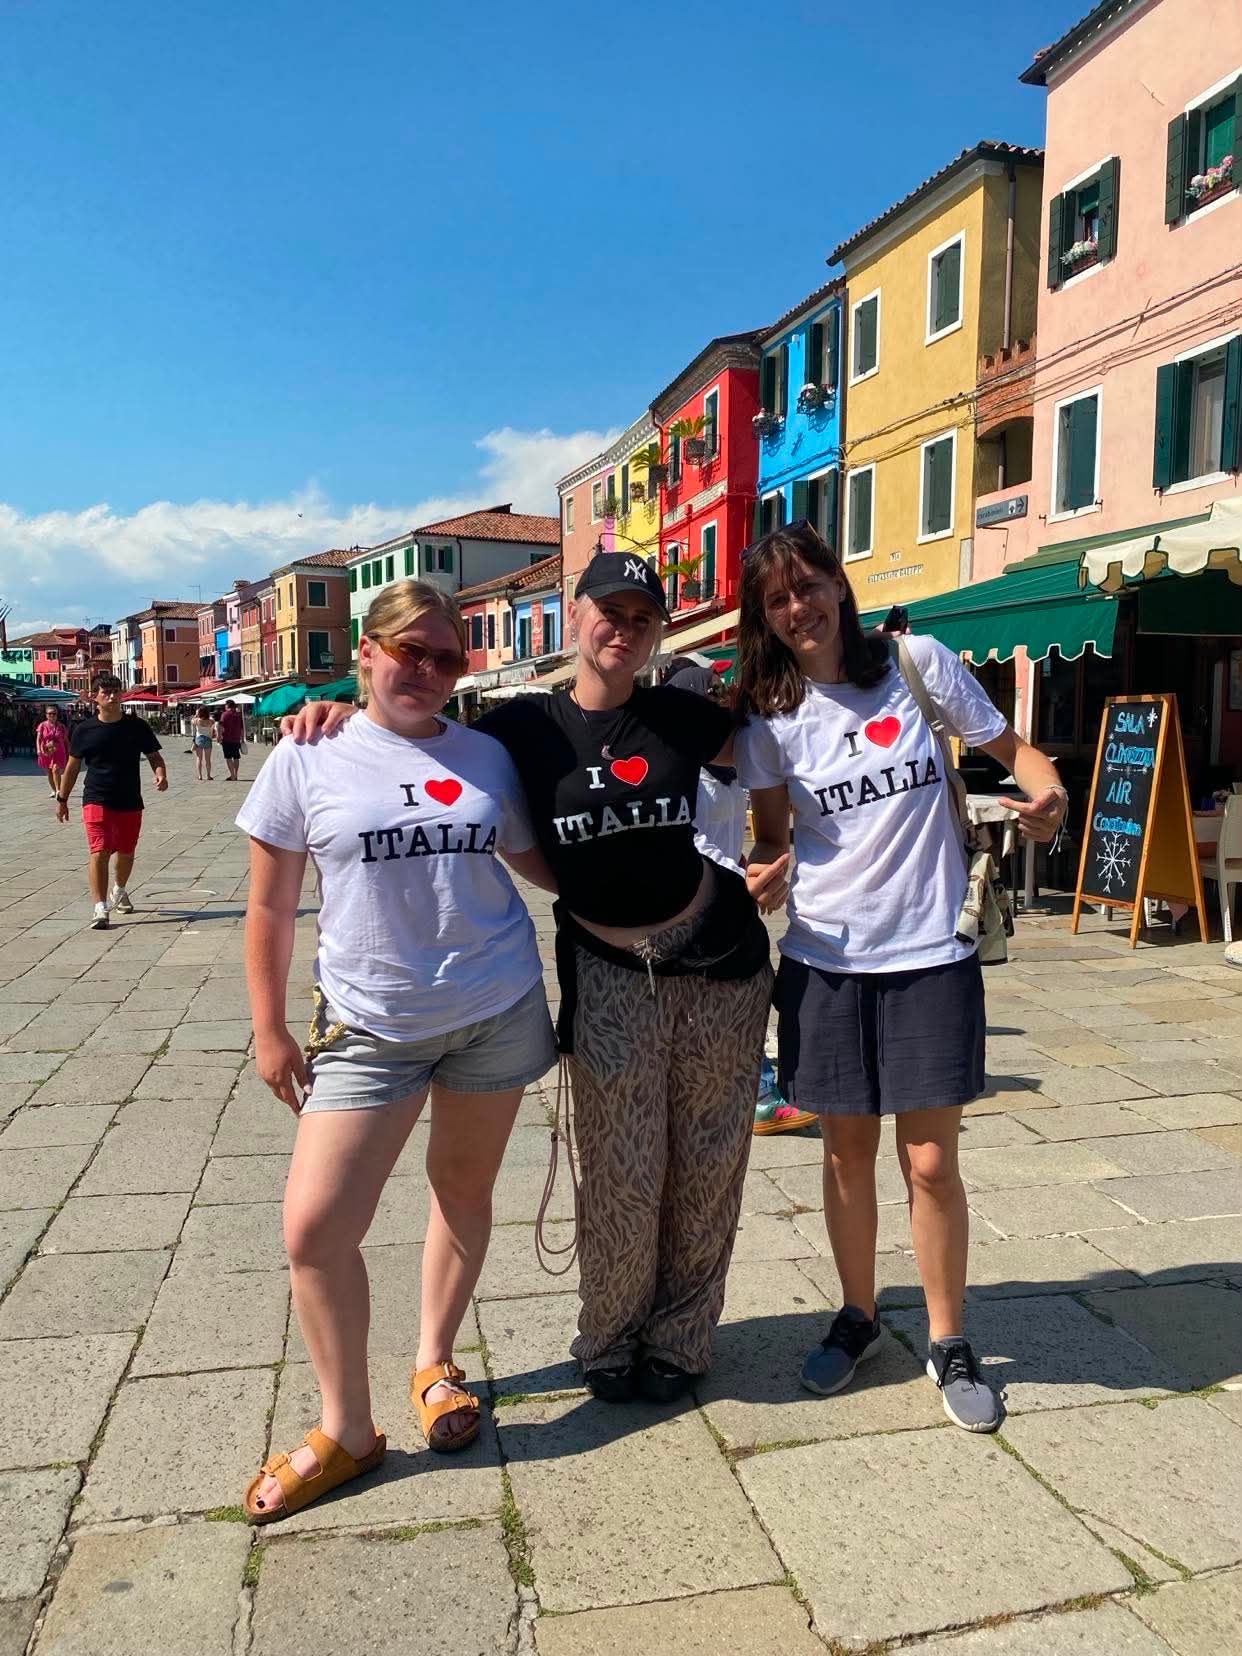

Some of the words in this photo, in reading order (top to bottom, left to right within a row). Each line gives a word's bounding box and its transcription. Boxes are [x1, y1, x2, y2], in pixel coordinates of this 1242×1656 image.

[624, 559, 647, 584] NY
[1114, 711, 1146, 735] SALA
[844, 731, 862, 757] I
[586, 766, 605, 789] I
[814, 757, 942, 816] ITALIA
[1106, 777, 1133, 804] AIR
[400, 784, 419, 806] I
[553, 795, 692, 844] ITALIA
[358, 823, 497, 863] ITALIA
